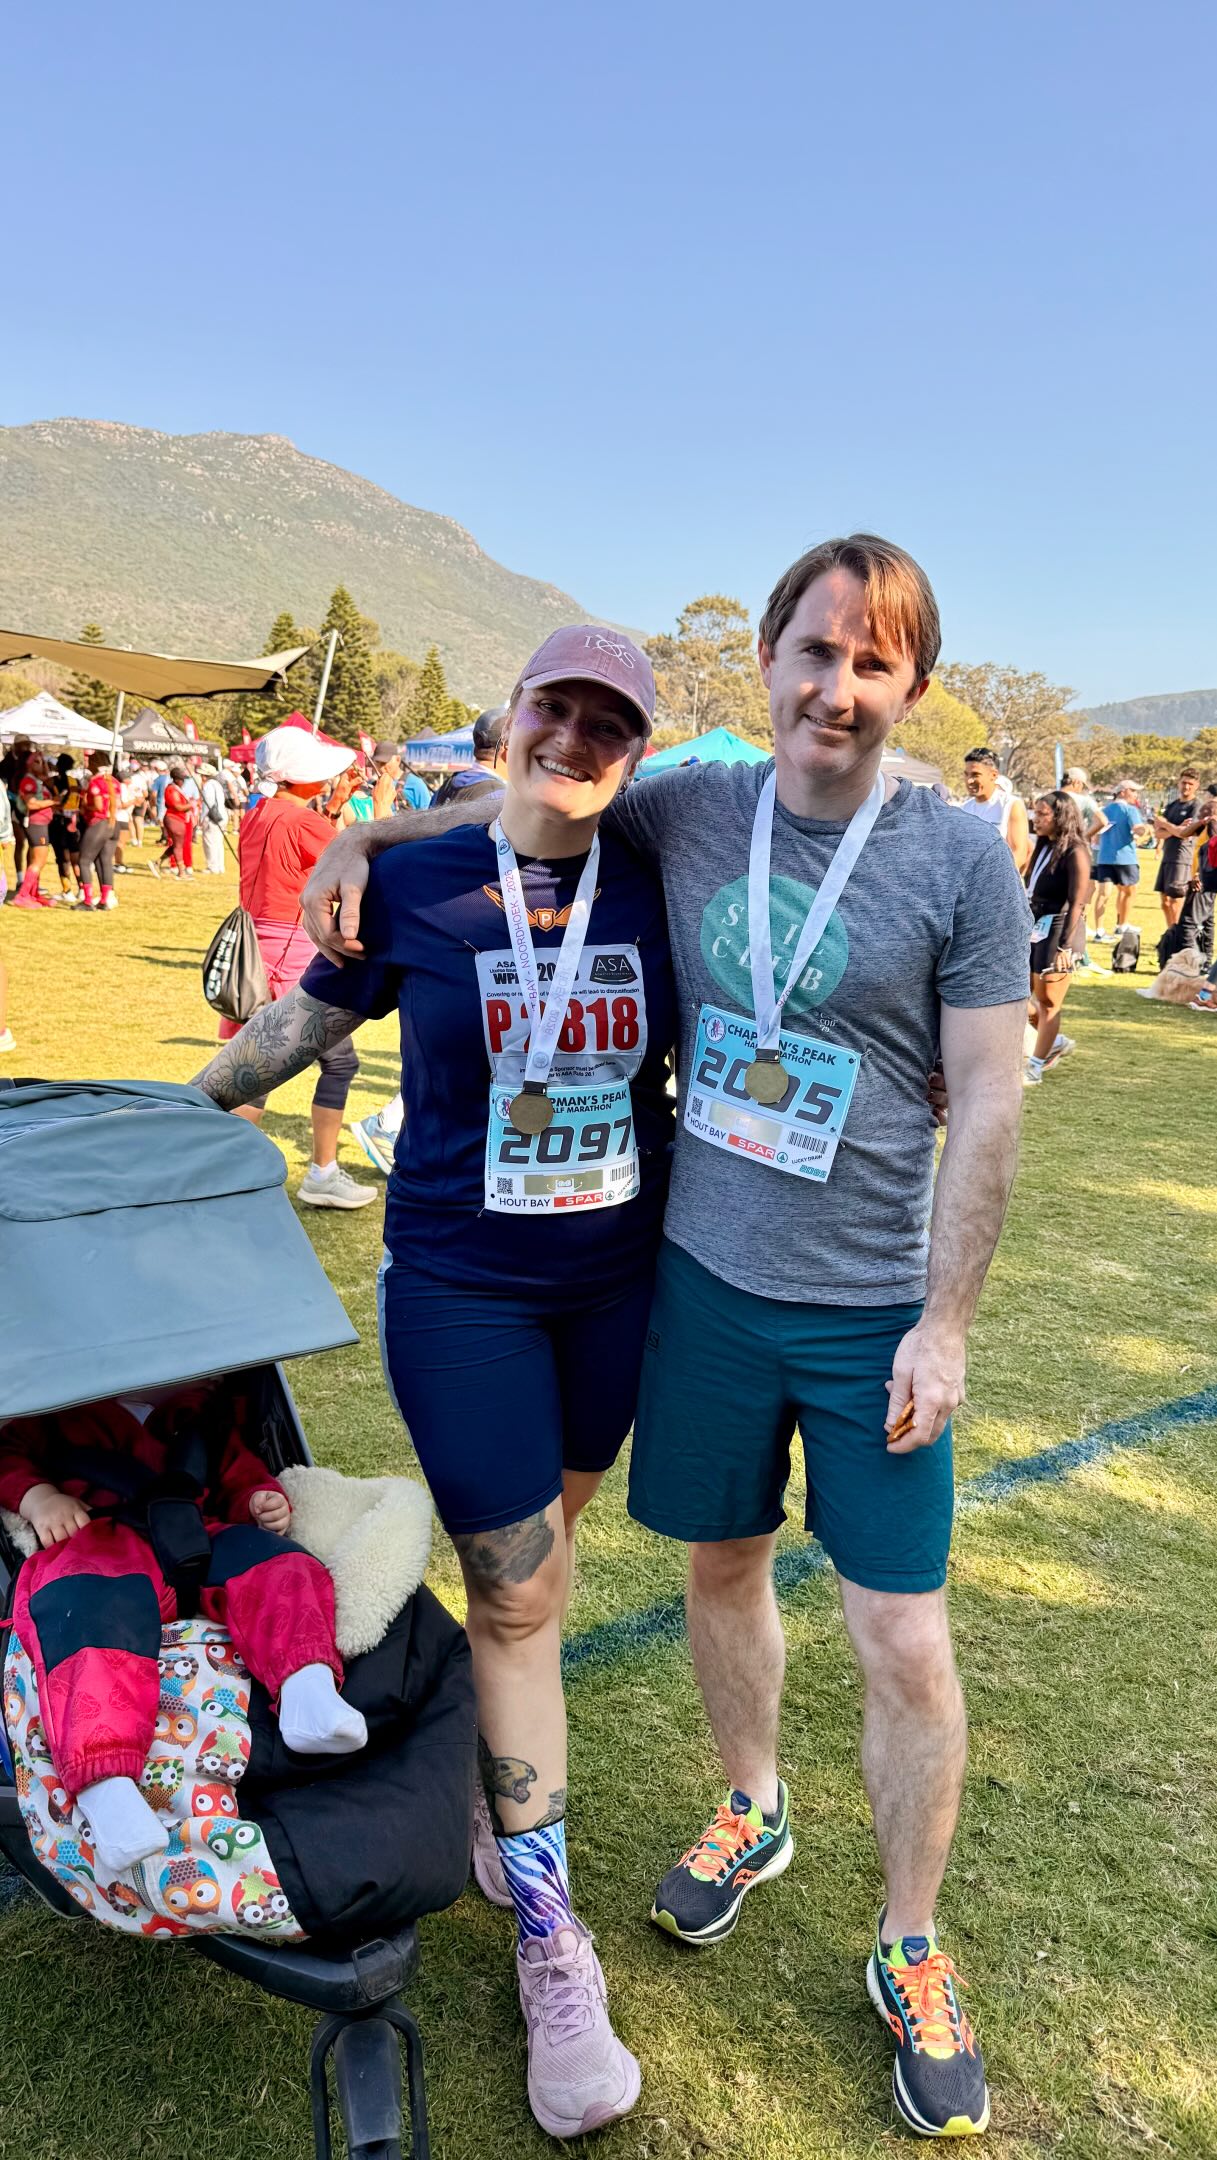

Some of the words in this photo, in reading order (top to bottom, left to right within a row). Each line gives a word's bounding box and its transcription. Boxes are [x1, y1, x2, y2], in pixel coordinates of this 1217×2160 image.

[541, 914, 551, 926] P
[509, 900, 530, 969] NOORDHOEK
[595, 957, 630, 973] ASA
[526, 979, 537, 999] BAY
[486, 999, 512, 1053] P
[727, 1024, 798, 1055] CHAPN'S
[802, 1046, 838, 1066] PEAK
[550, 1094, 599, 1107] PMAN'S
[602, 1089, 628, 1103] PEAK
[566, 1103, 612, 1114] MARATHON
[498, 1115, 632, 1164] 2097
[690, 1117, 709, 1133] HOUT
[709, 1126, 727, 1140] BAY
[738, 1138, 775, 1158] SPAR
[499, 1197, 528, 1207] HOUT
[531, 1198, 551, 1207] BAY
[565, 1194, 603, 1206] SPAR
